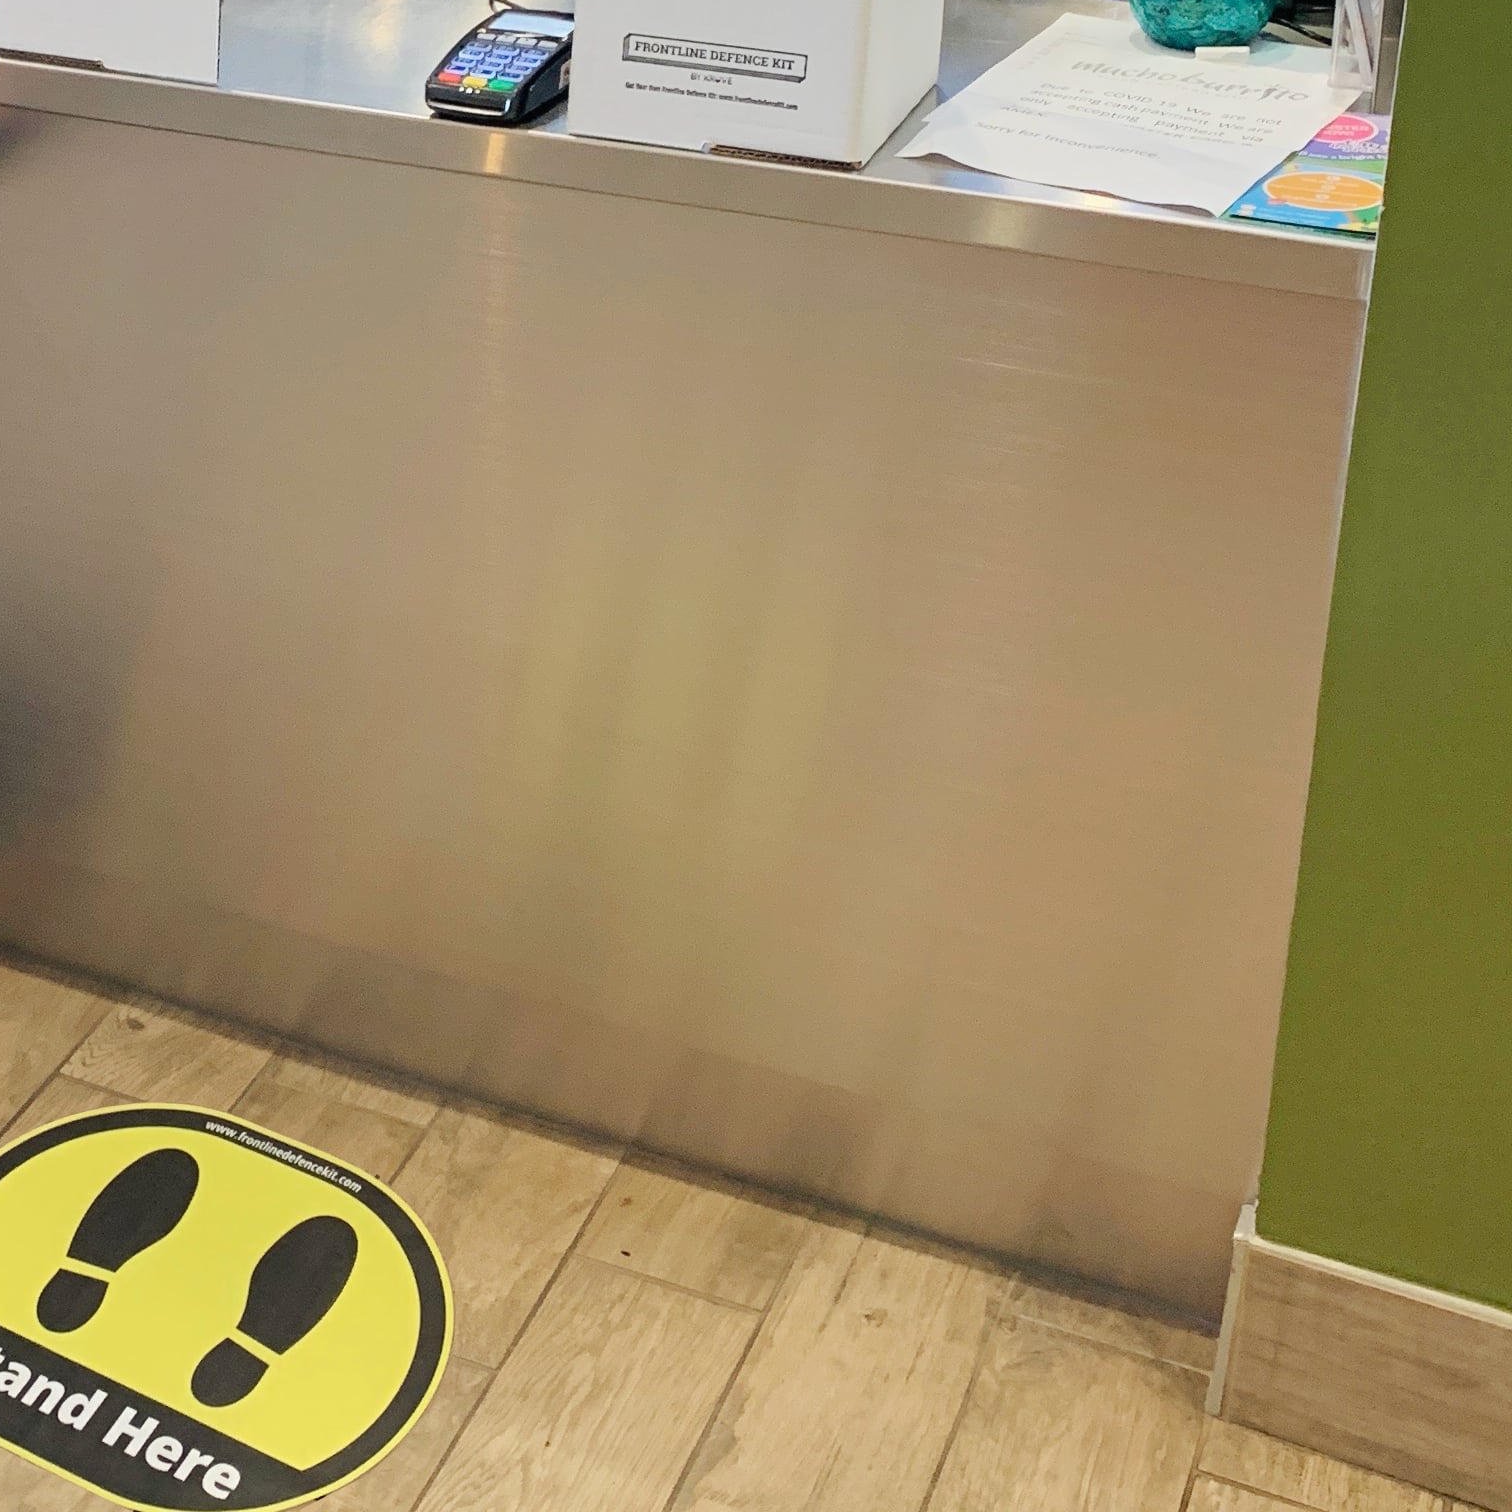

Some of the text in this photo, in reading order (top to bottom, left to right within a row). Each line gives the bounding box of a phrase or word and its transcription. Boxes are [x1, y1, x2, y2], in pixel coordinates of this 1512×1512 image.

[634, 41, 795, 70] FRONTLINE DEFENCE KIT
[1020, 96, 1052, 107] only
[1066, 103, 1140, 123] accepting
[1154, 118, 1225, 138] payment
[1241, 133, 1264, 143] via
[1031, 89, 1273, 134] accepting cash payment We are
[1040, 82, 1070, 91] Due
[1104, 90, 1153, 103] COVID
[1159, 100, 1177, 108] 19
[1186, 106, 1212, 116] We
[1222, 113, 1246, 121] are
[1256, 117, 1283, 126] not
[976, 120, 1018, 134] Sorry
[1019, 129, 1041, 139] for
[205, 1120, 363, 1194] www.frontlinedefencekit.com
[101, 1406, 241, 1501] Here
